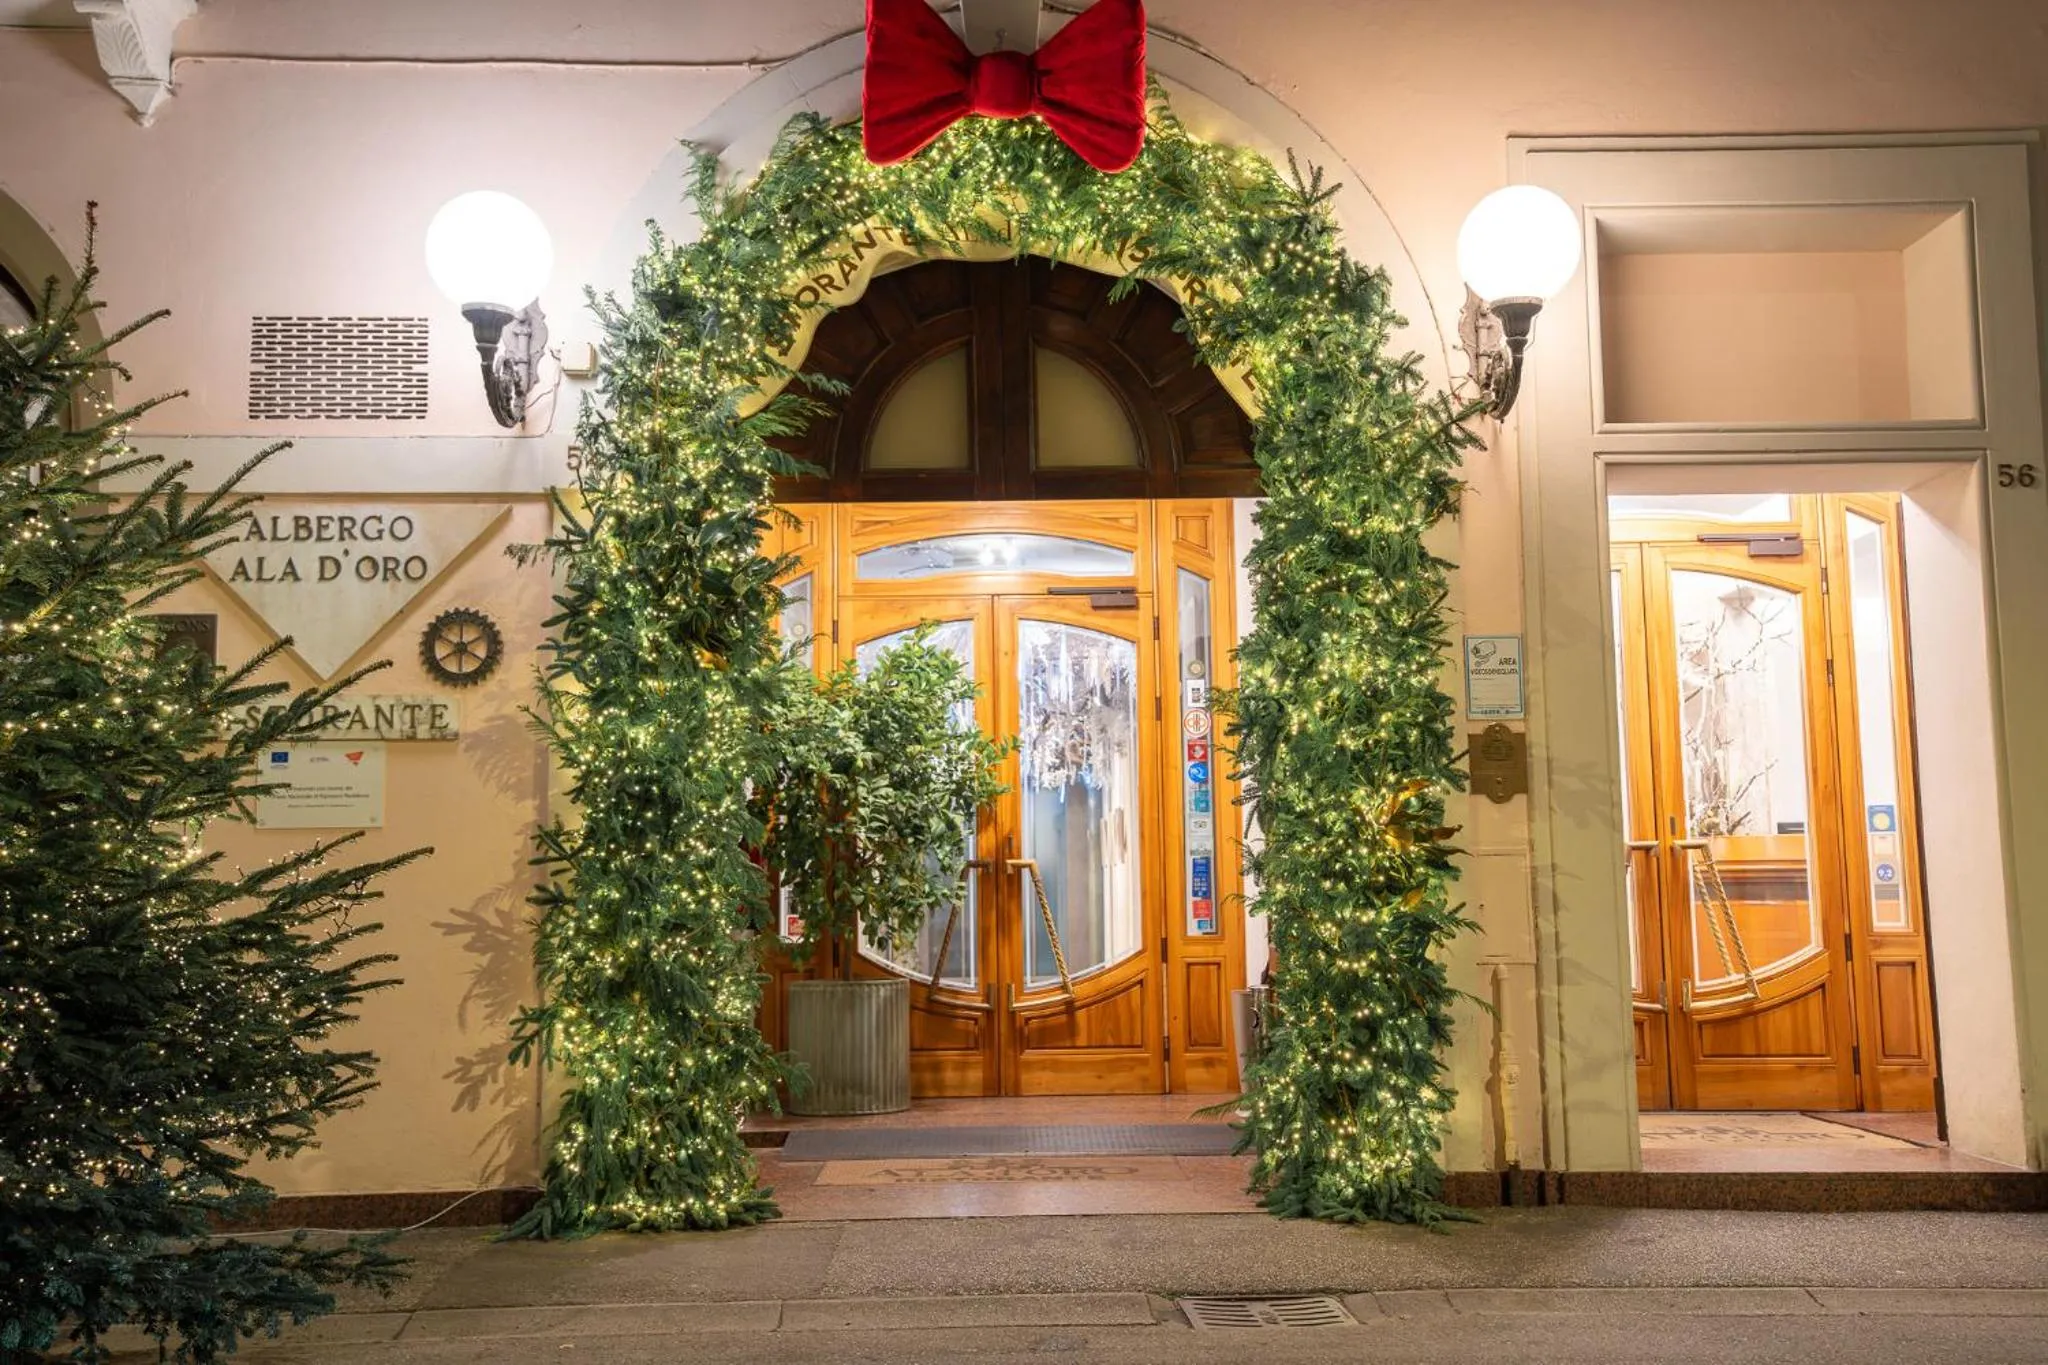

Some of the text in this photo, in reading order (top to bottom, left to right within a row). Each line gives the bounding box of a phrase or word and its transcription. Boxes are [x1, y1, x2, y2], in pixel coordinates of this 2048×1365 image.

[1998, 463, 2035, 488] 56
[244, 515, 414, 542] ALBERGO
[229, 548, 428, 582] ALA D'ORO
[1499, 657, 1518, 666] AREA
